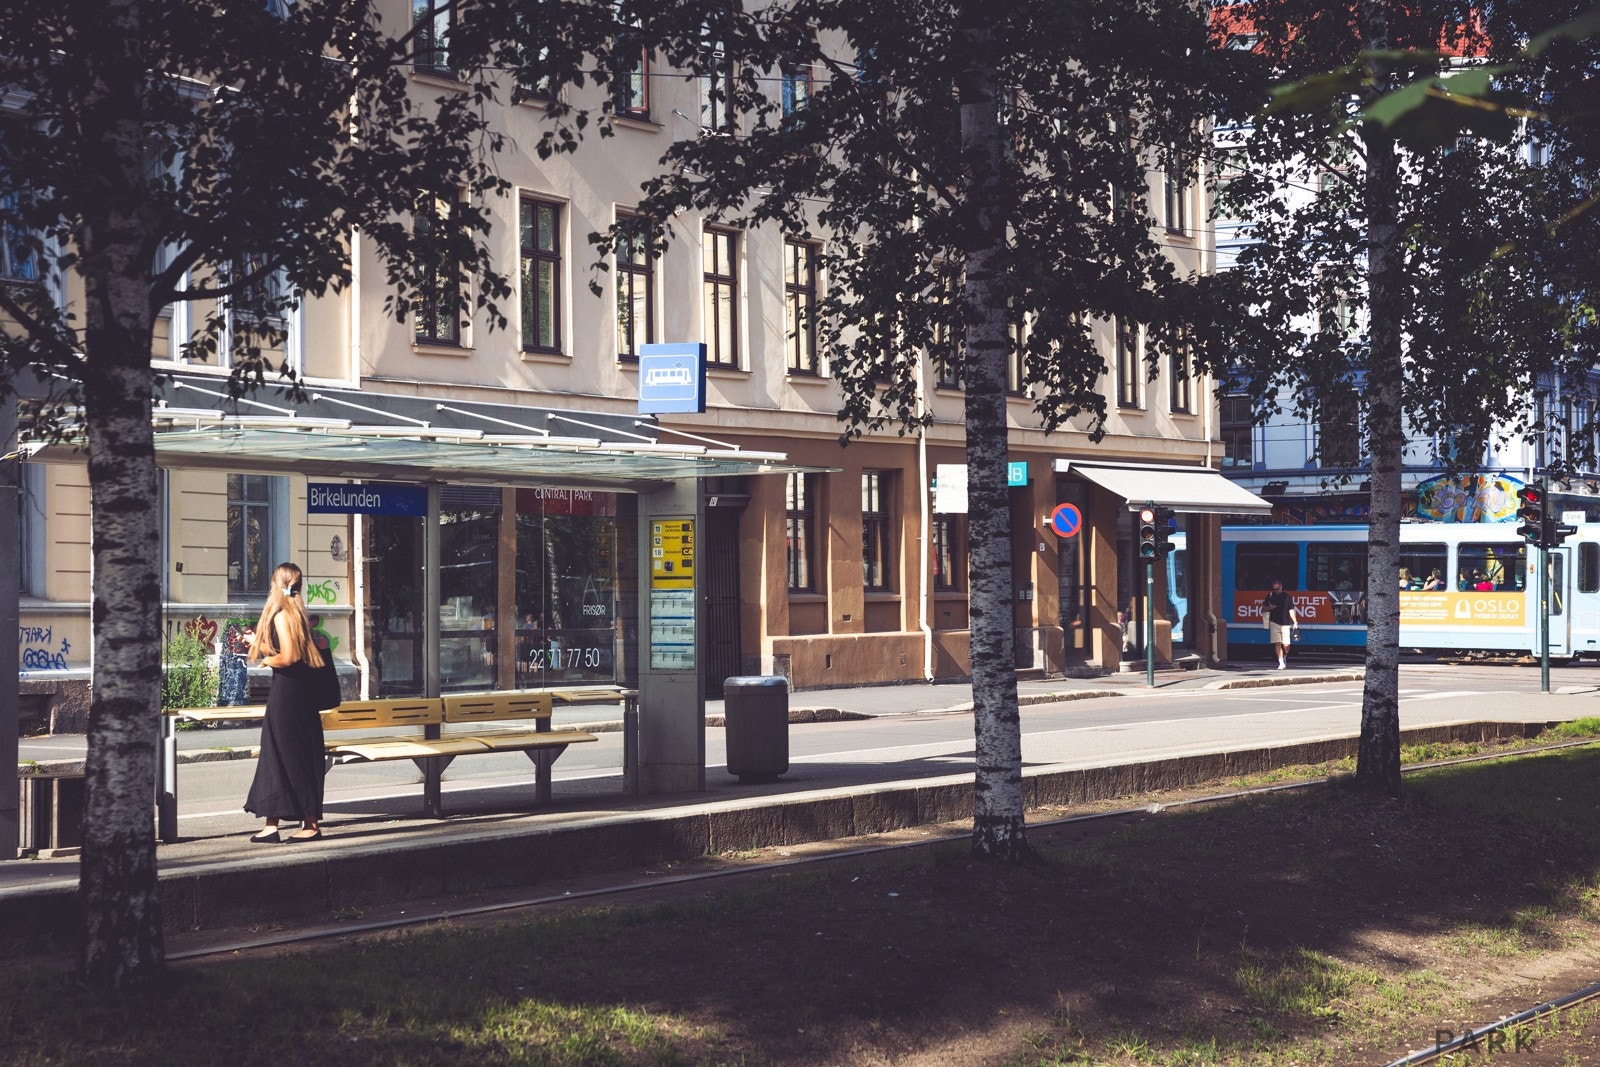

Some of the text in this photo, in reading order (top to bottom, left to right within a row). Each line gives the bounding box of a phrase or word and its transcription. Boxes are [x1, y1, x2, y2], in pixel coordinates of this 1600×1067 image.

[310, 487, 381, 507] Birkelunden
[574, 490, 593, 501] PARK
[1292, 596, 1327, 606] UTLET
[1474, 600, 1520, 613] OSLO
[582, 604, 606, 616] FRISØR
[529, 649, 545, 669] 22
[566, 648, 582, 668] 77
[584, 647, 600, 668] 50
